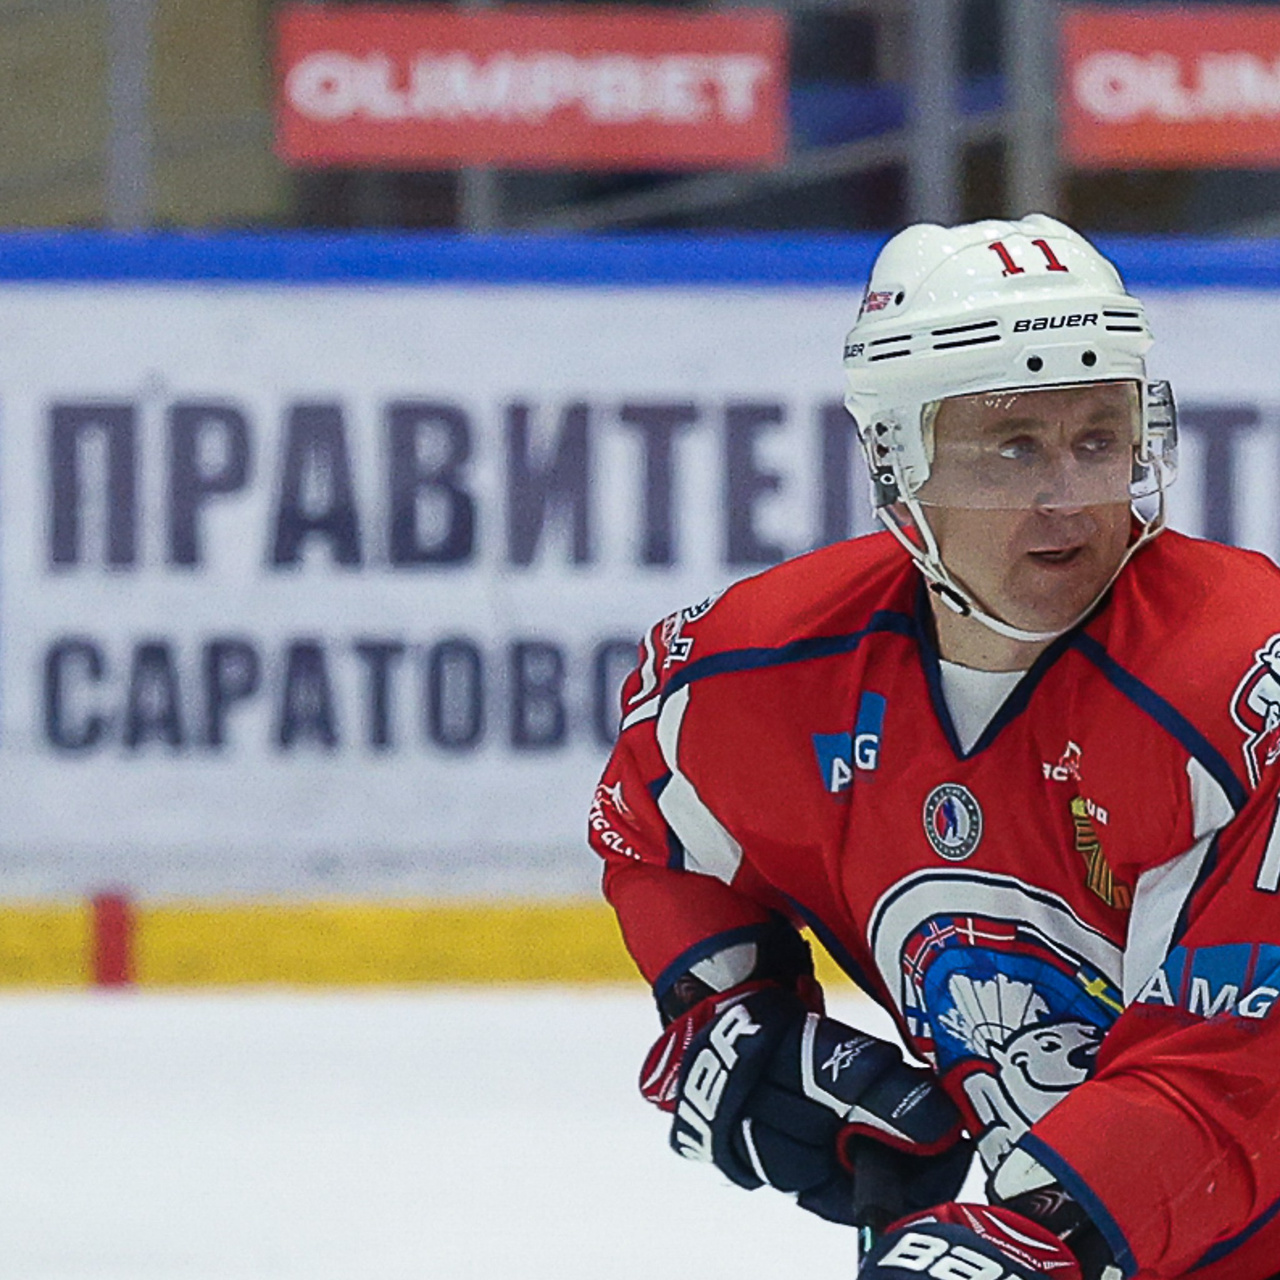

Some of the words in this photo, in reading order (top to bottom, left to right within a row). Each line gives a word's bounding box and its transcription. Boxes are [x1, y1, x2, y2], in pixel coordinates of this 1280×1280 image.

[286, 50, 768, 122] OLIMPBET
[988, 238, 1069, 277] 11
[1136, 967, 1280, 1020] AMG
